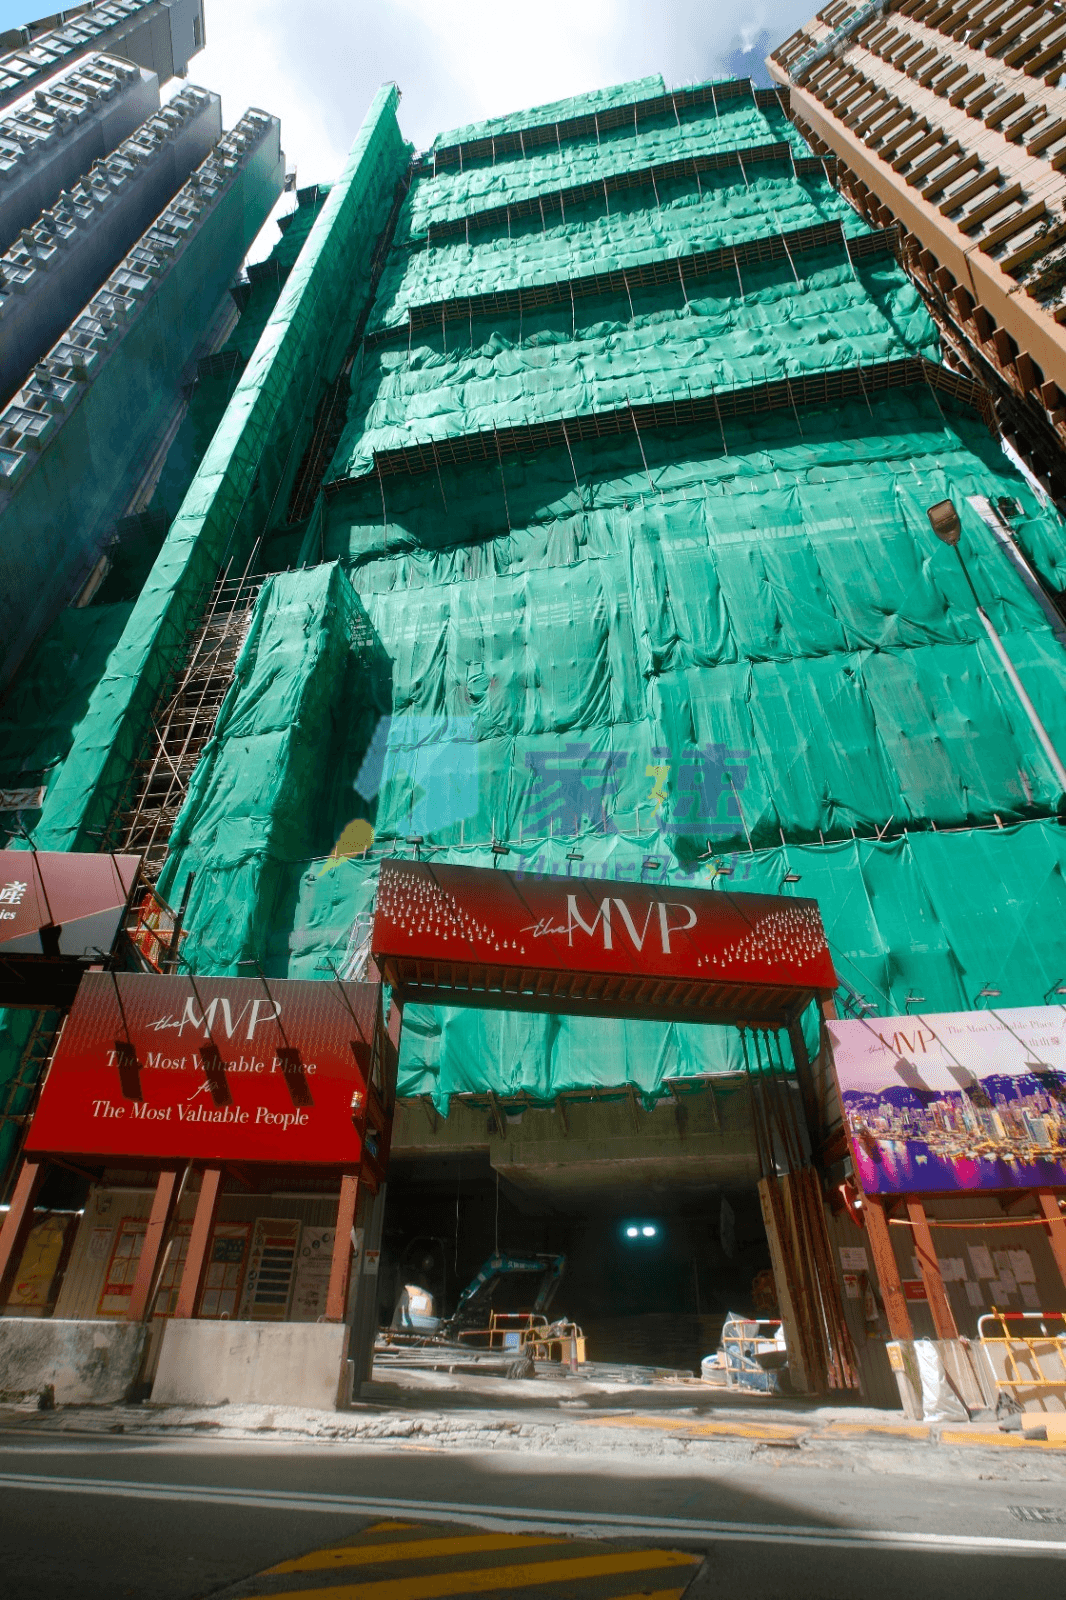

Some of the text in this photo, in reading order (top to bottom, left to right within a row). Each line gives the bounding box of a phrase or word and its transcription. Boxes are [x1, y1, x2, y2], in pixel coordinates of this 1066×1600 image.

[567, 894, 697, 954] MVP
[178, 996, 282, 1040] MVP
[879, 1029, 936, 1056] MVP
[106, 1049, 317, 1075] The Most Valuable Place
[92, 1100, 309, 1131] The Most Valuable People
